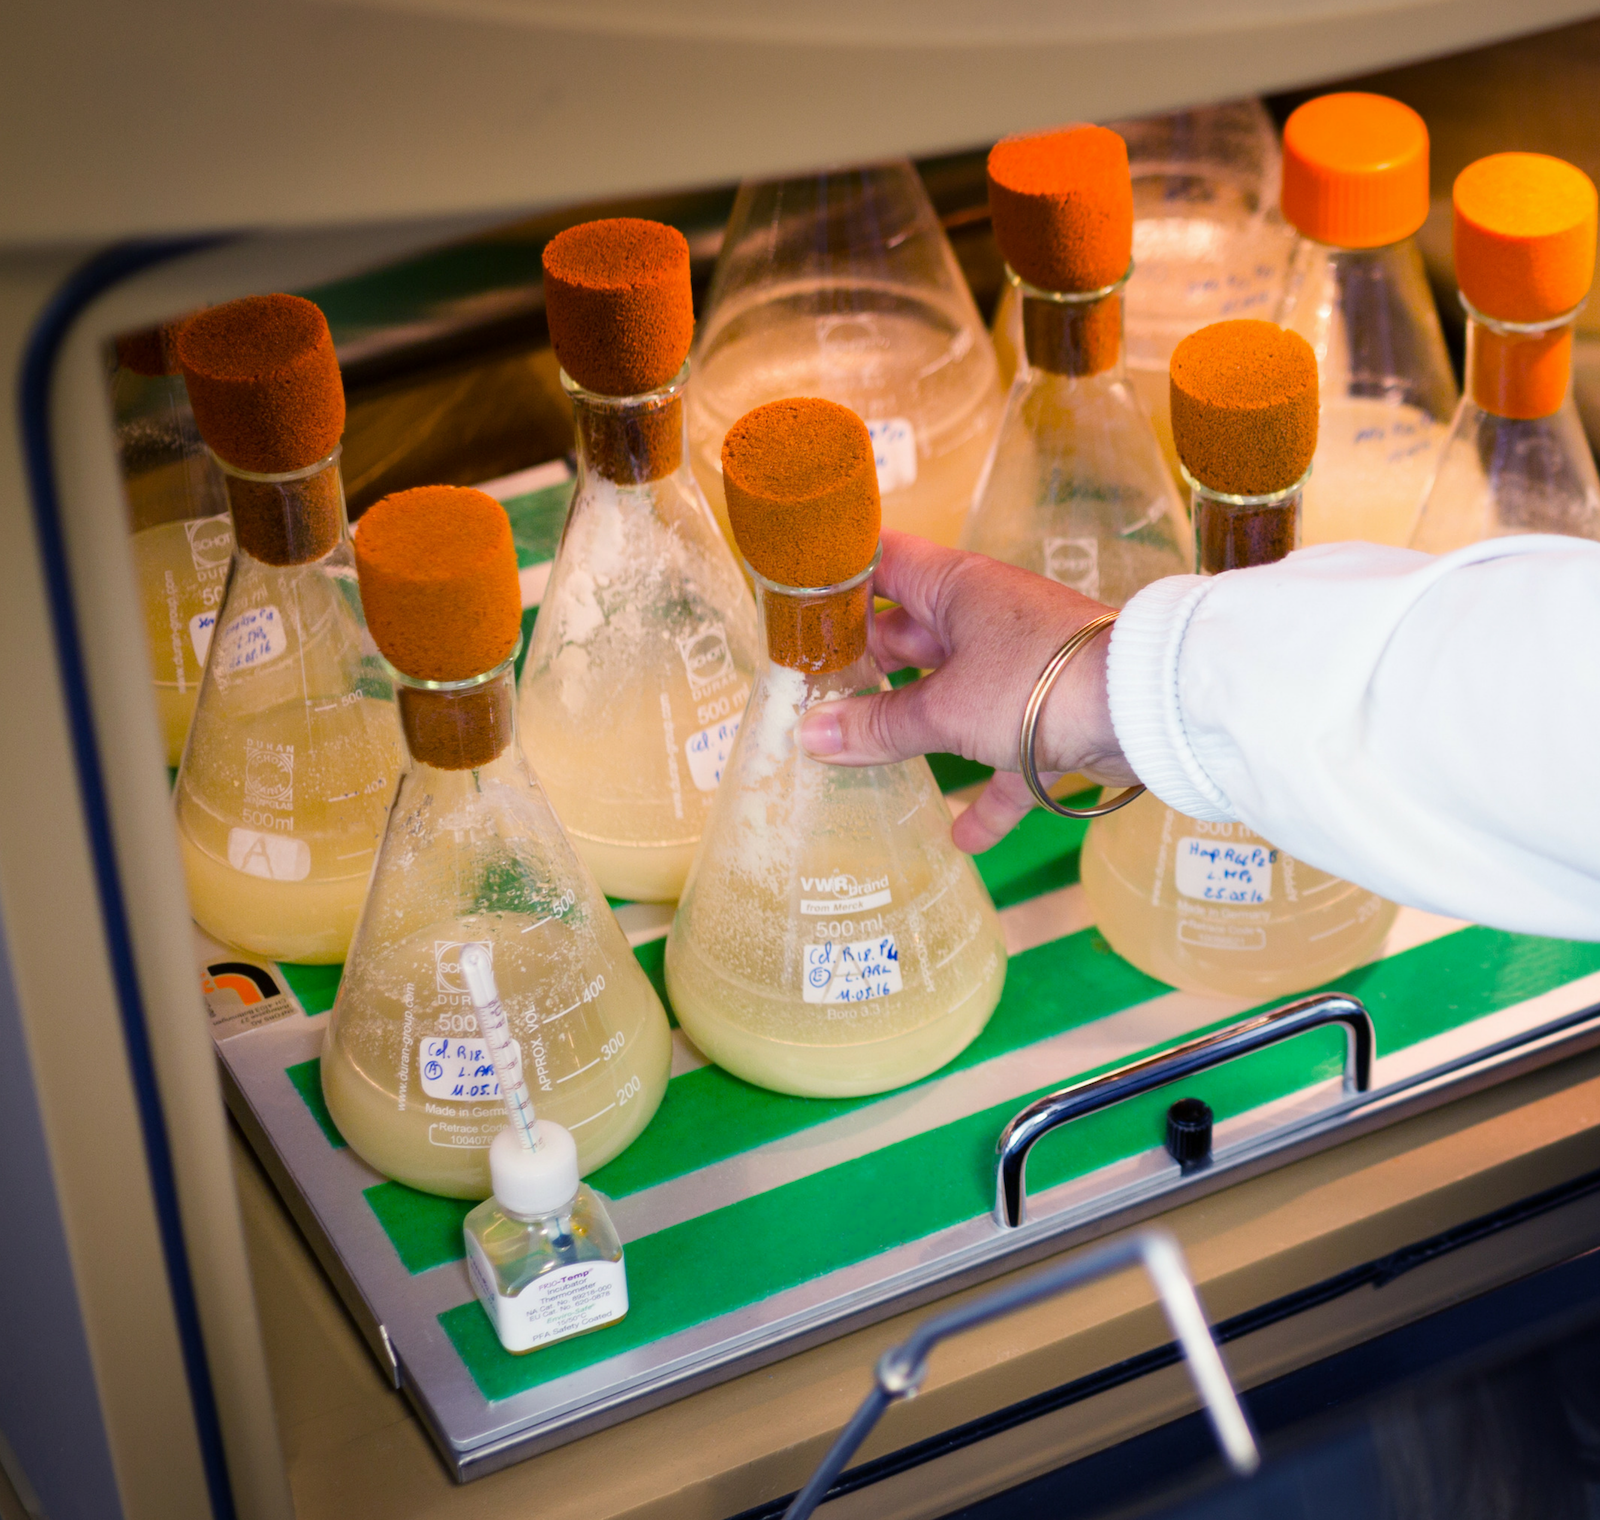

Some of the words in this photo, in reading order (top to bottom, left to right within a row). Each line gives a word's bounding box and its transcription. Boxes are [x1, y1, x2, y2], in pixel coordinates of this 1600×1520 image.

[193, 532, 230, 549] SCHOT
[342, 688, 364, 707] 500
[697, 697, 730, 725] 500
[733, 681, 751, 705] ml
[247, 738, 294, 753] DURAN
[364, 777, 387, 796] 400
[239, 835, 275, 879] A
[552, 887, 576, 919] 500
[806, 903, 830, 913] from
[833, 901, 864, 912] Merck
[816, 920, 853, 938] 500
[860, 913, 883, 933] ml
[583, 973, 606, 1003] 400
[438, 994, 472, 1006] DUR
[525, 1000, 539, 1034] VOL.
[827, 1007, 857, 1021] Boro
[861, 1004, 880, 1017] 3.3
[439, 1014, 477, 1032] 500
[398, 982, 415, 1111] www.duran-group.com
[601, 1031, 625, 1061] 300
[531, 1034, 553, 1091] APPROX.
[616, 1075, 641, 1106] 200
[425, 1102, 456, 1117] Made
[459, 1106, 470, 1117] in
[439, 1121, 480, 1135] Retrace
[481, 1123, 508, 1135] Code
[540, 1281, 597, 1304] Thermometer
[547, 1277, 588, 1296] Incubator
[526, 1308, 538, 1317] NA
[540, 1303, 554, 1313] Cat.
[557, 1298, 570, 1307] No.
[529, 1313, 541, 1322] EU
[542, 1309, 558, 1318] Cat.
[532, 1331, 552, 1342] PFA
[552, 1320, 580, 1335] Safety
[581, 1310, 613, 1326] Coated
